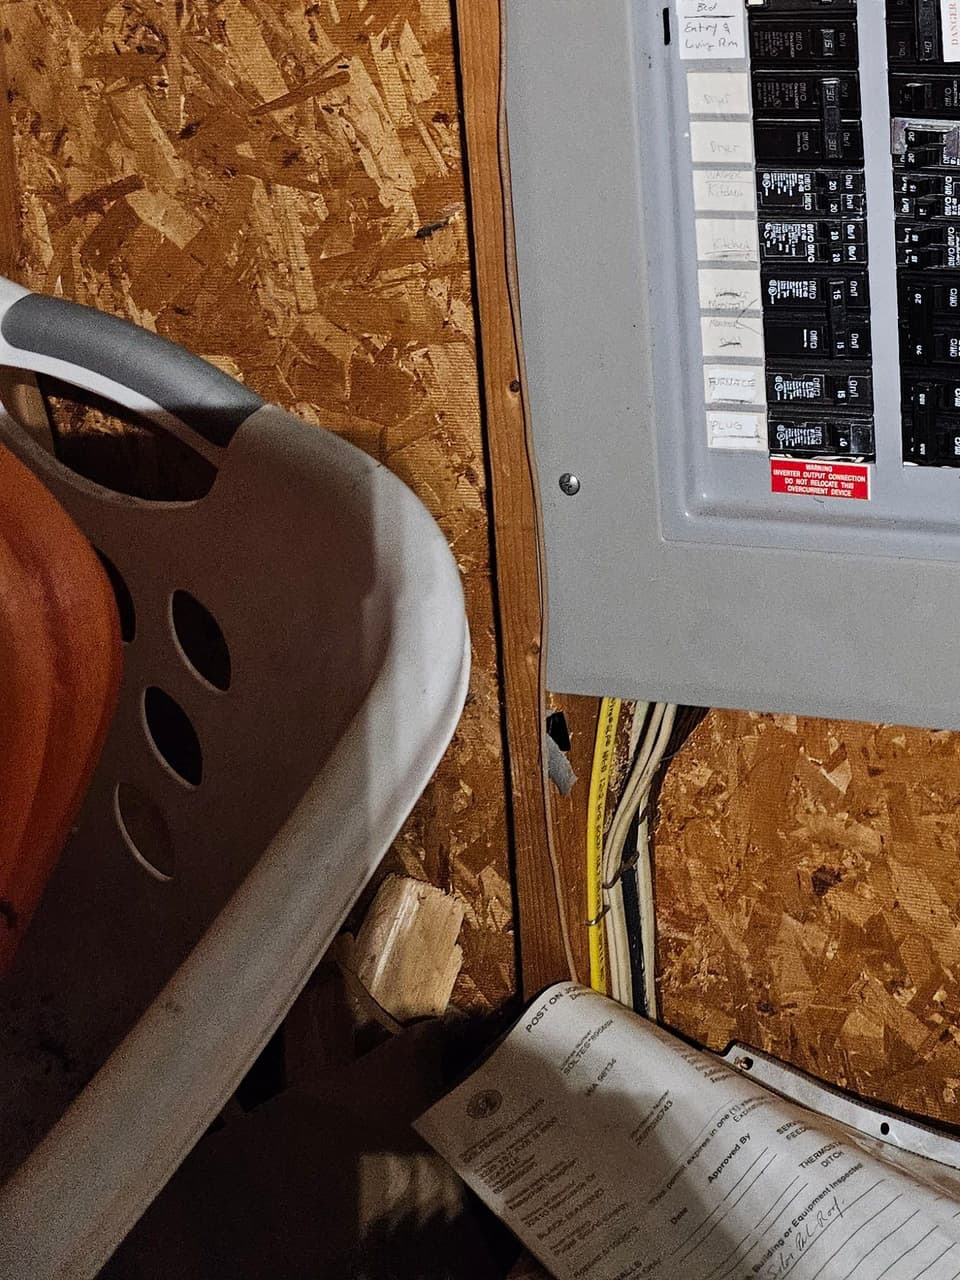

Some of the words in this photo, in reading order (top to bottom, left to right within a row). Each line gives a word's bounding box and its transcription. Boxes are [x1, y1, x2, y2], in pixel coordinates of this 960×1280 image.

[948, 2, 959, 46] DANGER
[773, 469, 801, 477] INVERTER
[802, 471, 826, 479] OUTPUT
[828, 473, 866, 483] CONNECTION
[805, 463, 833, 472] WARNING
[787, 485, 828, 495] OVERCURRENT
[830, 488, 852, 497] DEVICE
[810, 479, 838, 488] RELOCATE
[840, 481, 854, 489] THIS
[525, 1005, 549, 1033] POST
[548, 991, 564, 1006] ON
[707, 1144, 742, 1184] Approved
[740, 1132, 752, 1146] By
[751, 1237, 785, 1274] Building
[783, 1226, 794, 1239] or
[791, 1187, 832, 1228] Equipment
